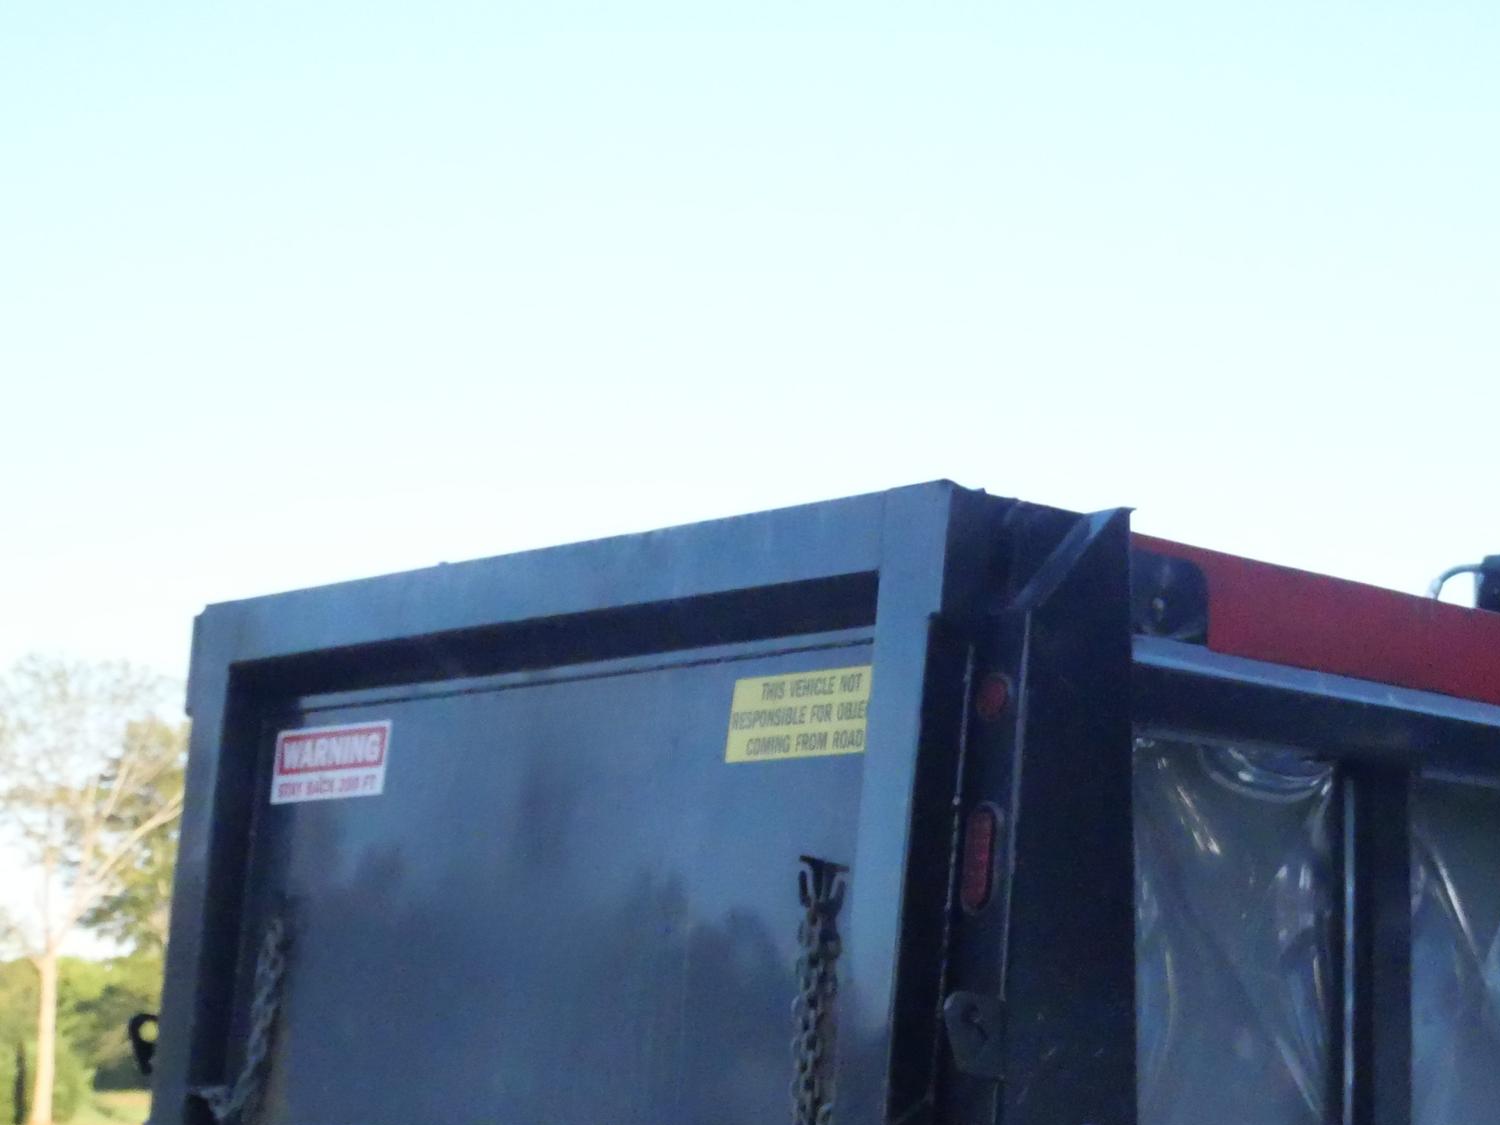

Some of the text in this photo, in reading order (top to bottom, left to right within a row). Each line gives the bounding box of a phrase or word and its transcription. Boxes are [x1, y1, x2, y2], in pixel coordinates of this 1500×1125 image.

[762, 673, 863, 701] THIS VEHICLE NOT
[732, 705, 807, 730] RESPONSIBLE
[810, 703, 832, 723] FOR
[284, 734, 380, 769] WARNING
[746, 729, 865, 756] COMING FROM ROAD
